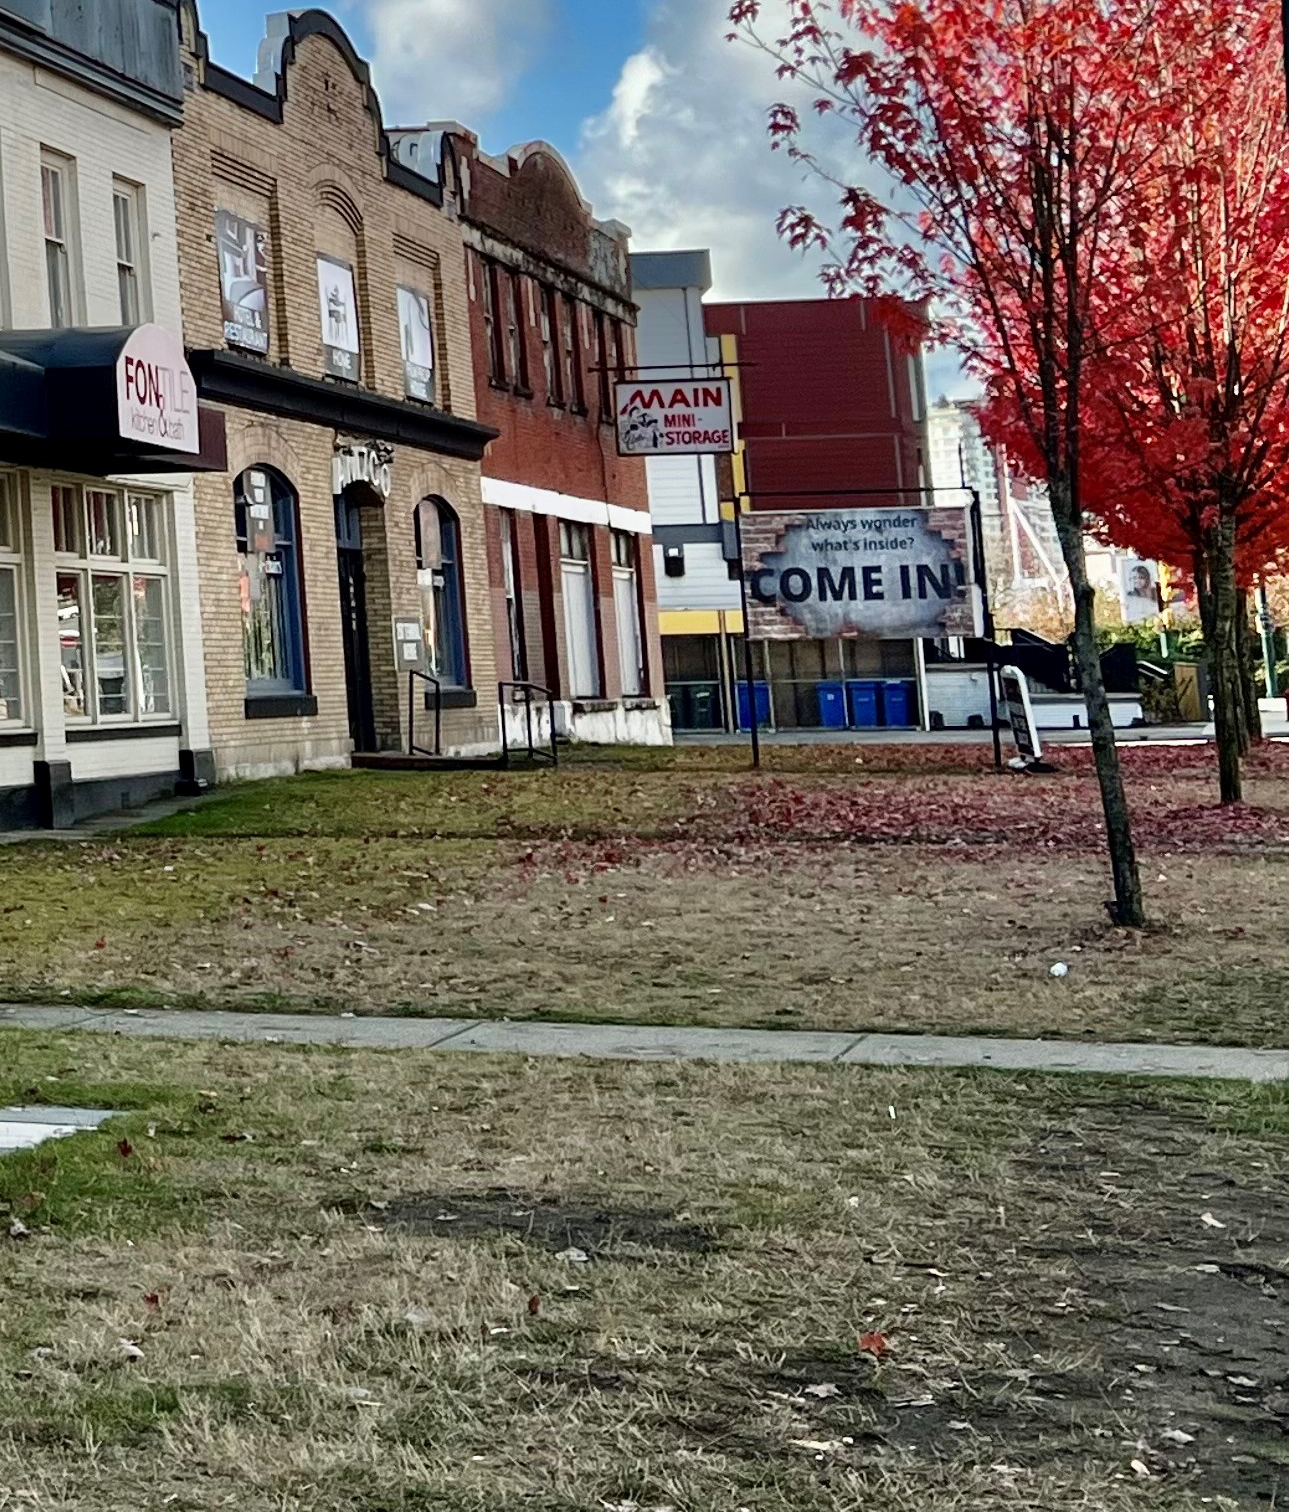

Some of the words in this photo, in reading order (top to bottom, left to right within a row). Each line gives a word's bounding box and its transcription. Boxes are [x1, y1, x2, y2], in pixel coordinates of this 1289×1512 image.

[125, 355, 190, 414] FONTILE
[620, 386, 722, 415] MAIN
[665, 429, 730, 446] STORAGE
[806, 517, 858, 533] Always
[860, 515, 918, 532] wonder
[811, 538, 860, 552] what's
[863, 537, 915, 550] inside?
[749, 564, 885, 603] COME
